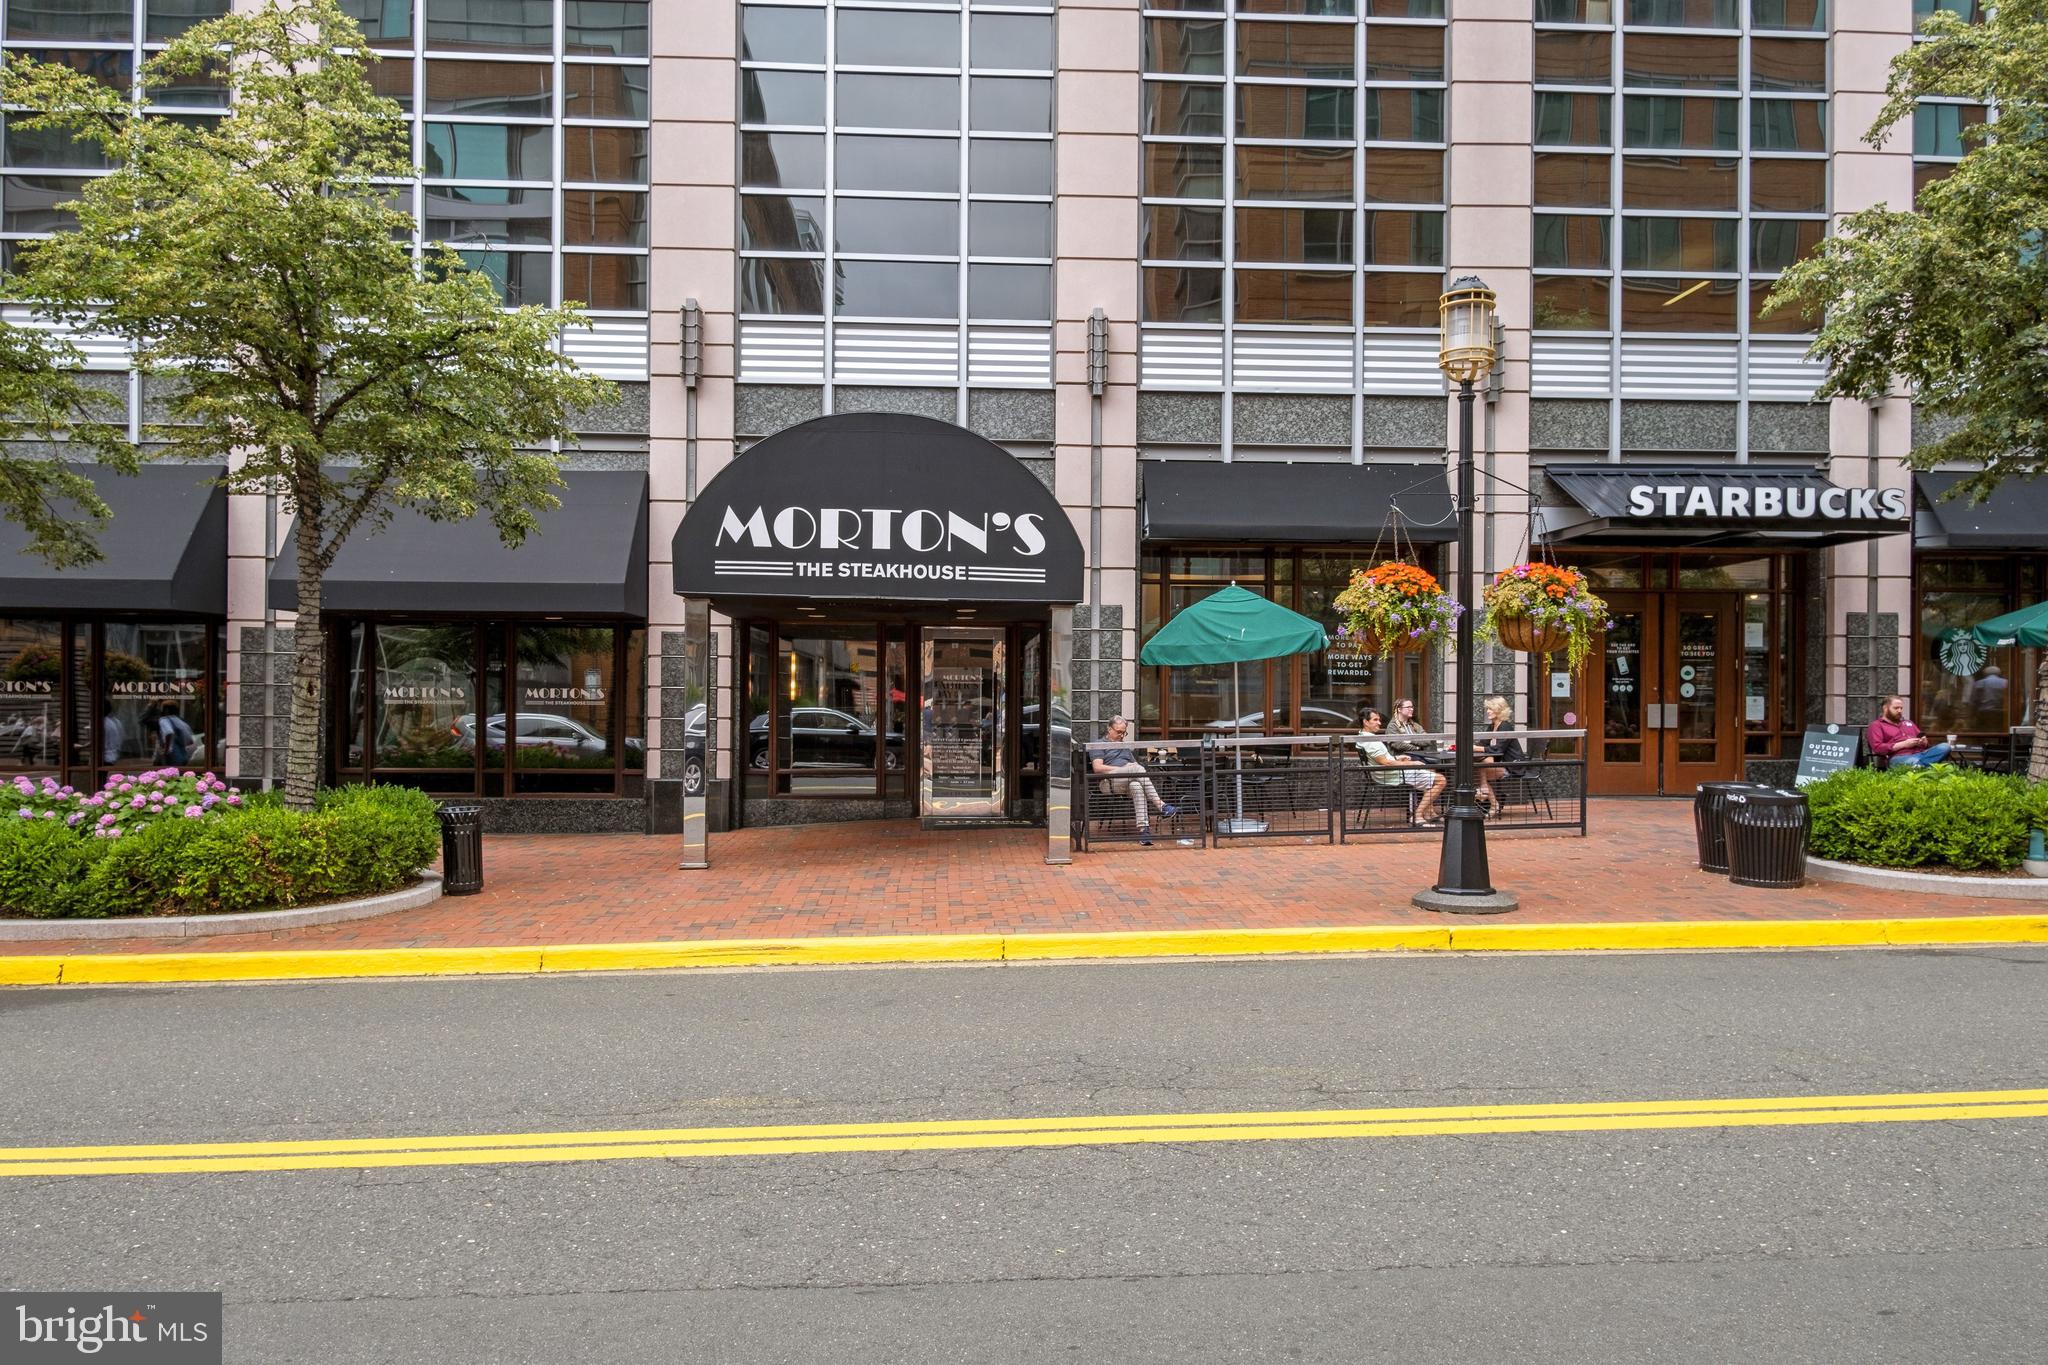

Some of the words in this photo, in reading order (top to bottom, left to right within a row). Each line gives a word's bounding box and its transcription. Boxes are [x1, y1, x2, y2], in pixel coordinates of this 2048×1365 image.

[1629, 485, 1906, 520] STARBUCKS
[715, 504, 1046, 556] MORTON'S
[796, 562, 833, 577] THE
[838, 562, 966, 581] STEAKHOUSE
[112, 681, 196, 693] MORTON'S
[384, 687, 465, 698] MORTON'S
[525, 687, 605, 699] MORTON'S
[1809, 743, 1850, 753] OUTDOOR
[1812, 749, 1844, 757] PICKUP
